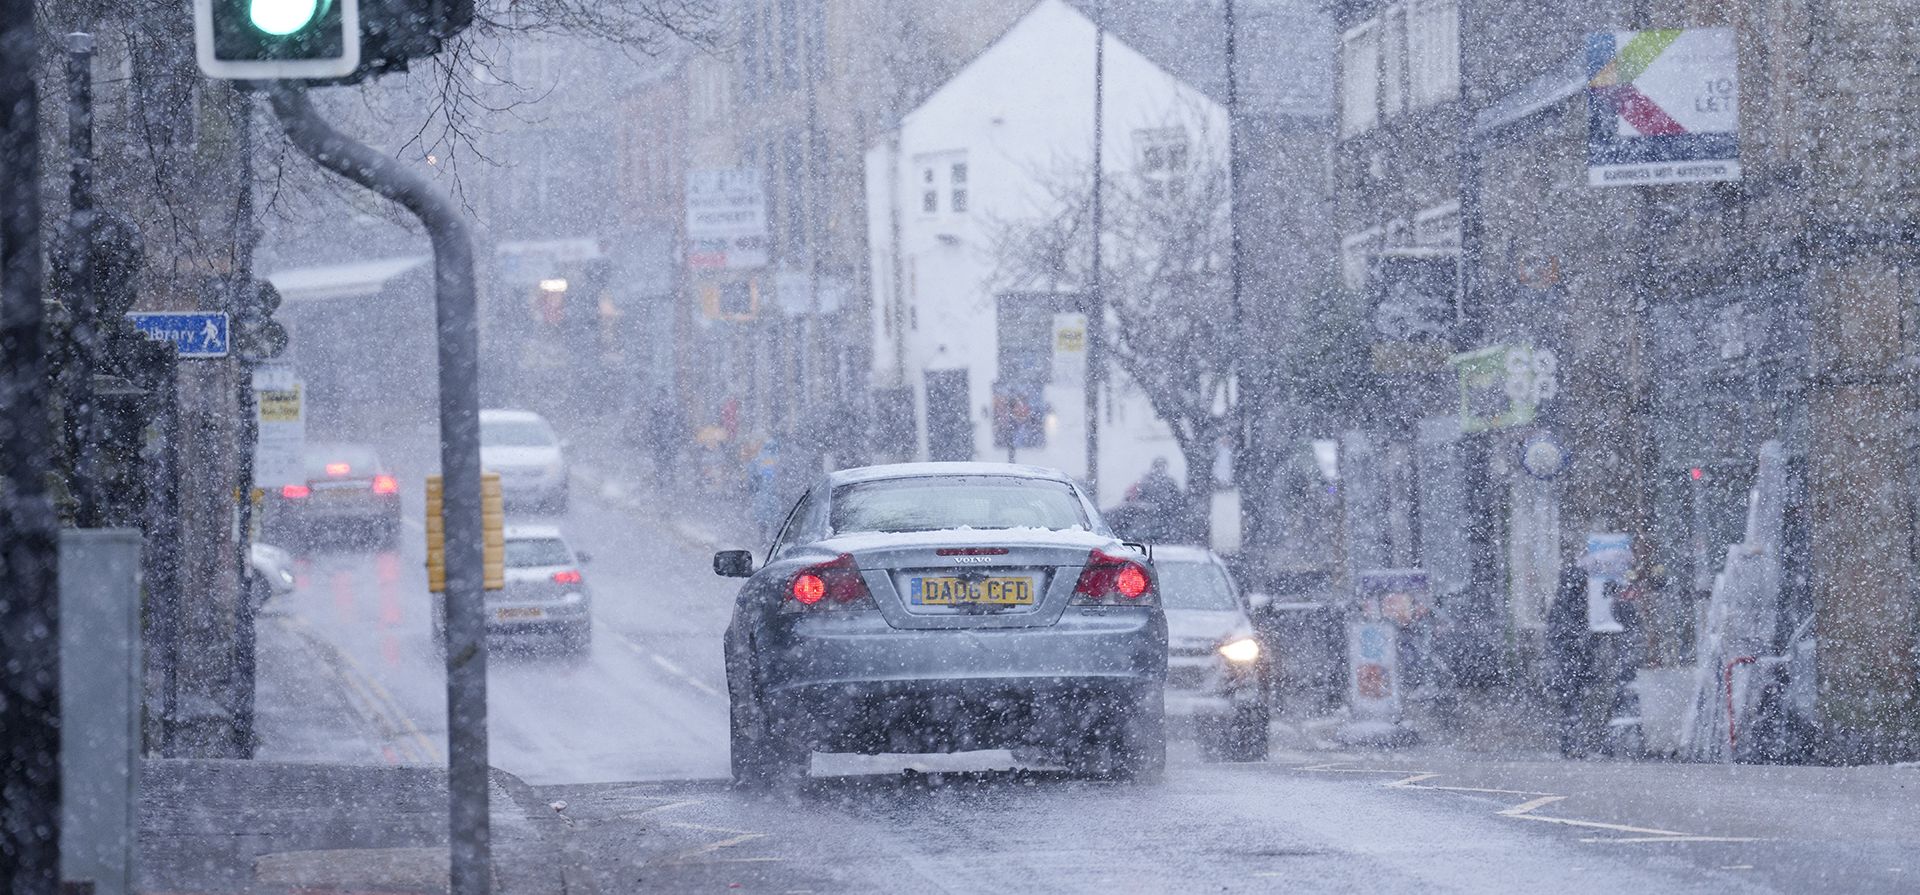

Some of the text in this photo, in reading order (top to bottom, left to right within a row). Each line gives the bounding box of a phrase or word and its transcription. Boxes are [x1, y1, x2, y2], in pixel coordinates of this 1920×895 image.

[1706, 78, 1733, 94] TO
[1695, 96, 1732, 112] LET
[145, 326, 195, 343] ibrary
[987, 581, 1029, 600] CFD
